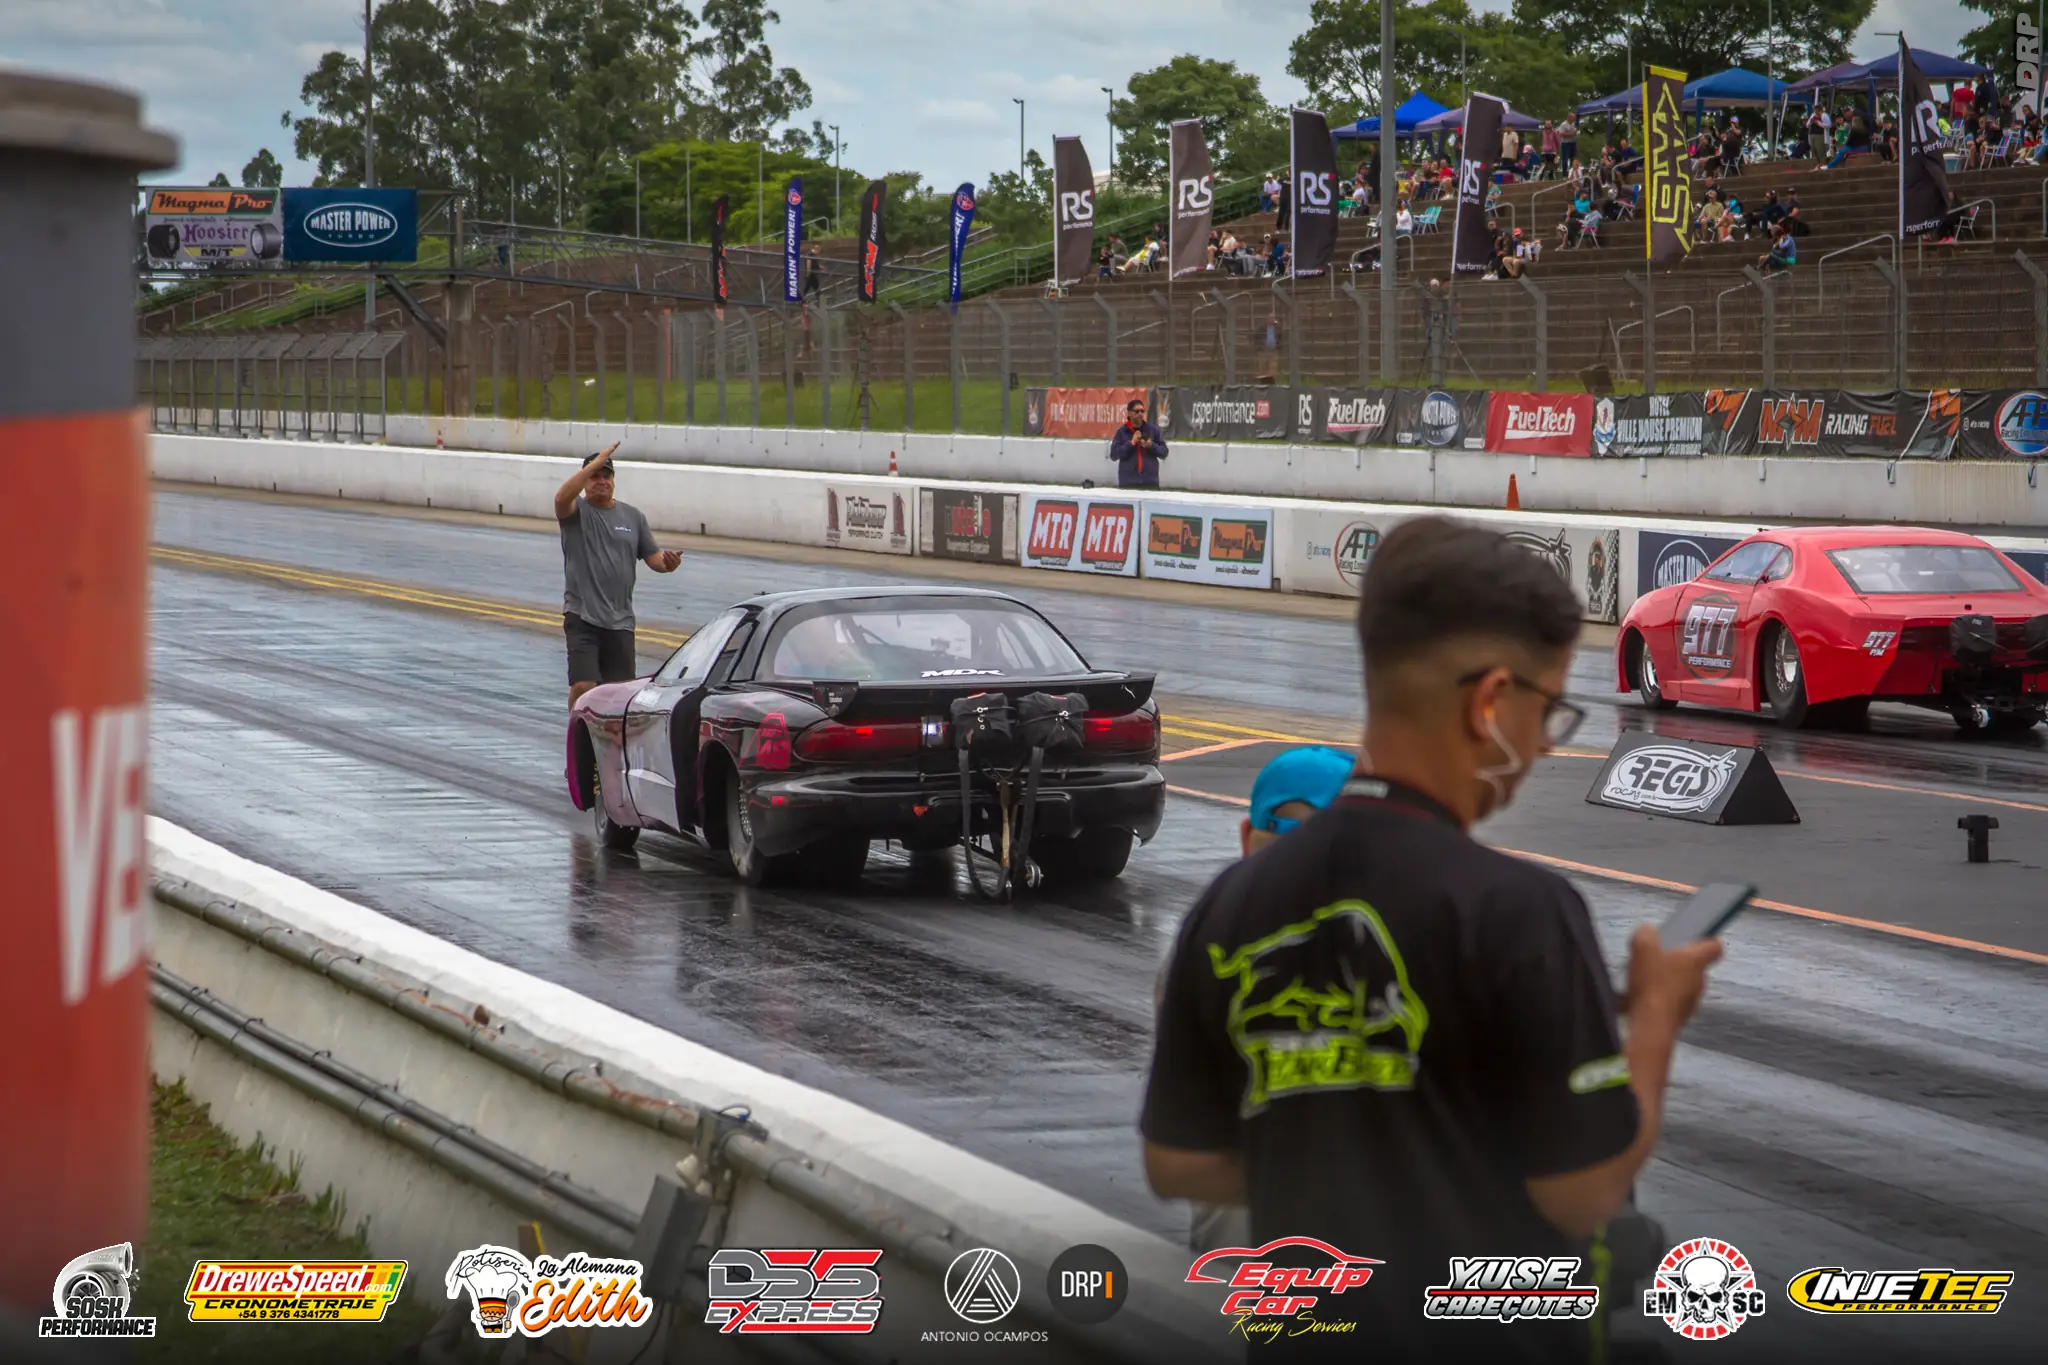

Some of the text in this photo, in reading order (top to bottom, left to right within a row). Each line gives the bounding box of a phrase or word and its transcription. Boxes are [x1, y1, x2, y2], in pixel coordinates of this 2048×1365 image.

[1300, 171, 1336, 206] RS
[1463, 158, 1487, 195] RS
[156, 192, 273, 213] Magma Pro
[1061, 190, 1094, 222] RS
[1179, 175, 1213, 210] RS
[181, 222, 250, 243] Hoosier
[310, 210, 391, 231] MASTER POWER
[200, 248, 234, 257] M/T
[788, 208, 799, 298] MAKIN' POWER!
[1298, 394, 1313, 426] RS
[1327, 398, 1386, 426] FuelTech
[1506, 405, 1576, 436] FuelTech
[1825, 413, 1869, 436] RACING
[1868, 413, 1897, 437] FUEL
[1032, 512, 1073, 550] MTR
[1086, 515, 1128, 554] MTR
[1683, 604, 1737, 656] 977
[1862, 630, 1897, 649] 977
